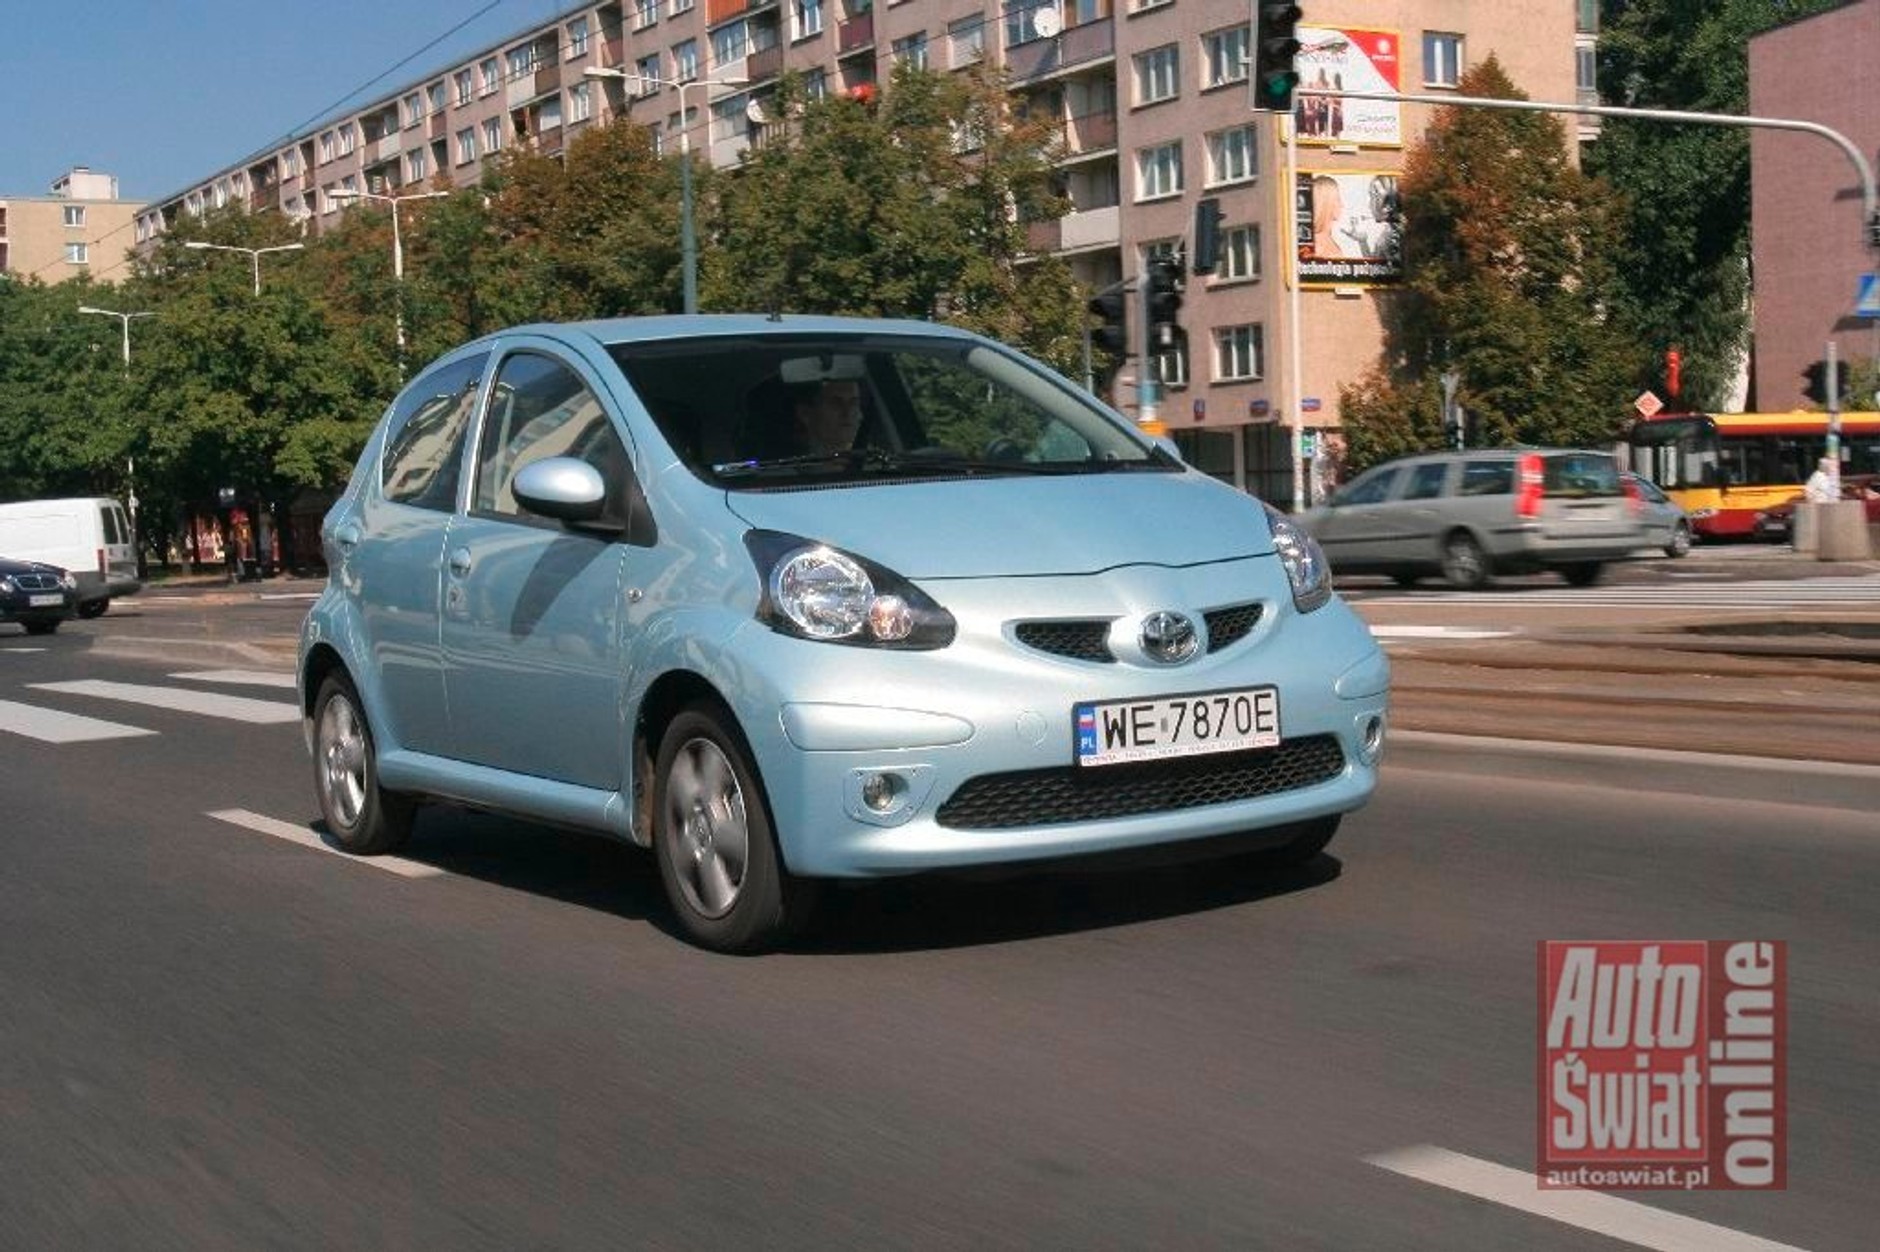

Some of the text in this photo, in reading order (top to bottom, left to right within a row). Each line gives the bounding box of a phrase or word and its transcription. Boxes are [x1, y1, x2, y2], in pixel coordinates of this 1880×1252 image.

[1103, 693, 1274, 750] WE 7870E
[1080, 737, 1095, 749] PL
